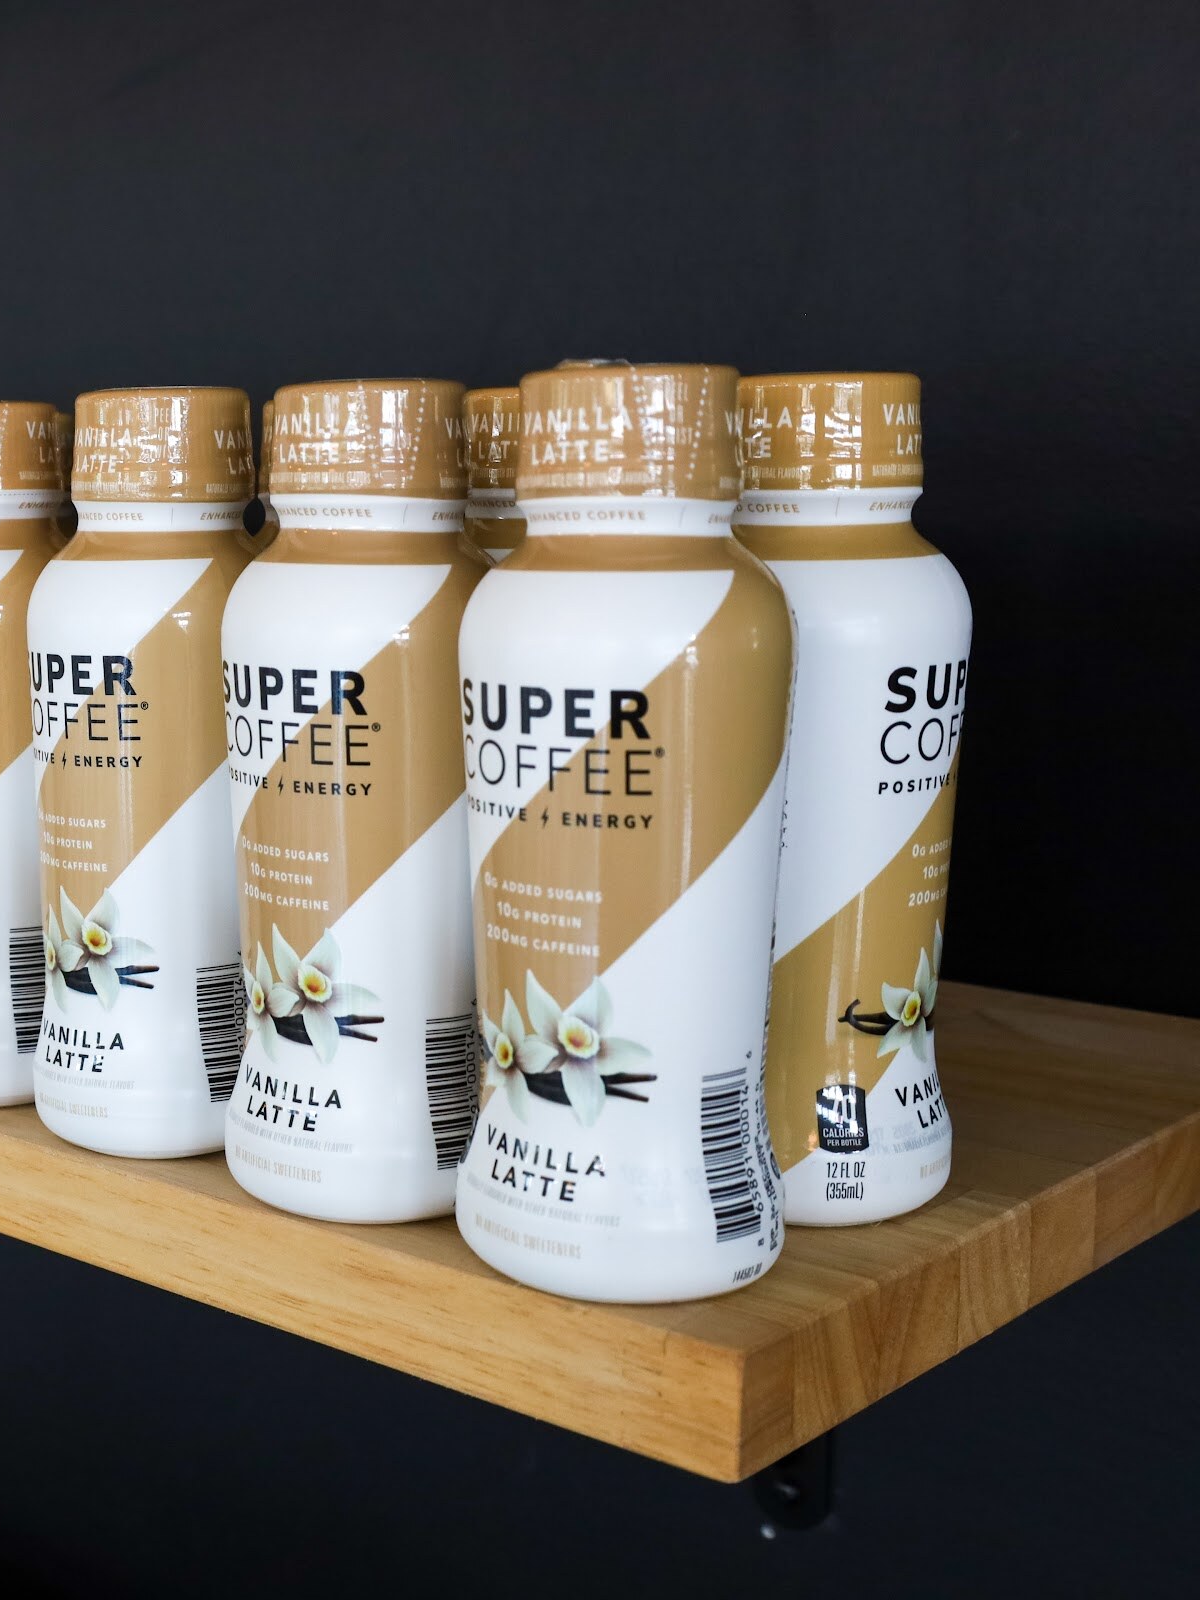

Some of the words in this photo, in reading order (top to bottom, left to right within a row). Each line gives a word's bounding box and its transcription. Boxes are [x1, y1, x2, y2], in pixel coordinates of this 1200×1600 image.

[275, 412, 358, 437] VANILLA
[524, 406, 633, 436] VANILLA
[279, 442, 340, 464] LATTE
[531, 439, 609, 466] LATTE
[106, 513, 144, 521] COFFEE
[322, 508, 373, 518] COFFEE
[587, 510, 646, 521] COFFEE
[748, 503, 800, 514] COFFEE
[31, 651, 137, 695] UPER
[223, 660, 368, 715] SUPER
[463, 678, 650, 739] SUPER
[75, 756, 142, 768] ENERGY
[294, 781, 372, 796] ENERGY
[878, 773, 950, 795] POSITIVE
[68, 817, 106, 828] SUGARS
[562, 812, 653, 829] ENERGY
[56, 838, 93, 850] PROTEIN
[253, 843, 281, 857] ADDED
[285, 849, 329, 862] SUGARS
[912, 844, 926, 858] 0G
[62, 860, 108, 872] CAFFEINE
[251, 862, 266, 878] 10G
[269, 870, 313, 885] PROTEIN
[923, 865, 939, 879] 10G
[244, 882, 273, 903] 200MG
[276, 895, 330, 911] CAFFEINE
[484, 871, 498, 889] 0G
[502, 880, 542, 897] ADDED
[547, 887, 602, 905] SUGARS
[497, 901, 519, 920] 10G
[524, 910, 582, 929] PROTEIN
[487, 923, 528, 948] 200MG
[532, 938, 600, 958] CAFFEINE
[43, 1018, 124, 1050] VANILLA
[46, 1045, 104, 1073] LATTE
[246, 1064, 342, 1109] VANILLA
[247, 1095, 318, 1132] LATTE
[740, 1085, 751, 1146] 00014
[488, 1123, 605, 1177] VANILLA
[827, 1138, 840, 1147] PER
[841, 1137, 862, 1146] BOTTLE
[491, 1158, 576, 1202] LATTE
[826, 1162, 837, 1178] 12
[840, 1162, 850, 1178] FL
[854, 1161, 866, 1178] OZ
[826, 1182, 864, 1201] (355mL)
